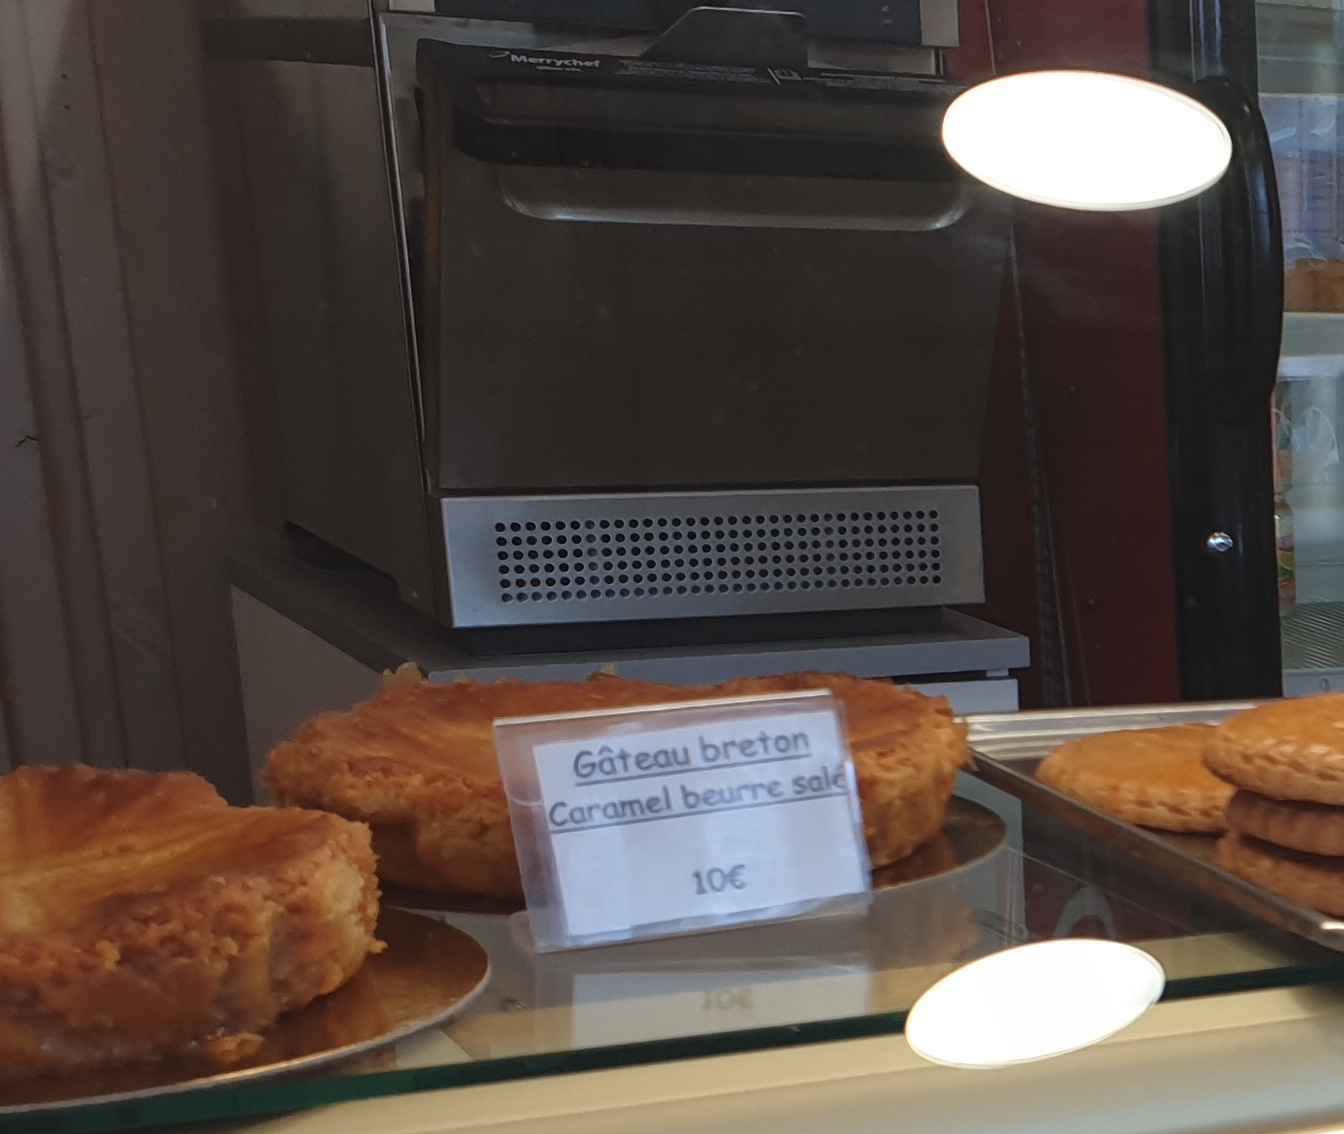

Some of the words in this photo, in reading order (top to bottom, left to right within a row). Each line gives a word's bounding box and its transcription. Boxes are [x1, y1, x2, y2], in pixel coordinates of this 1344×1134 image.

[510, 54, 600, 68] Merrychef
[573, 744, 691, 781] Gâteau
[700, 729, 809, 764] breton
[549, 784, 672, 828] Caramel
[681, 781, 785, 811] beurre
[691, 863, 748, 896] 10€
